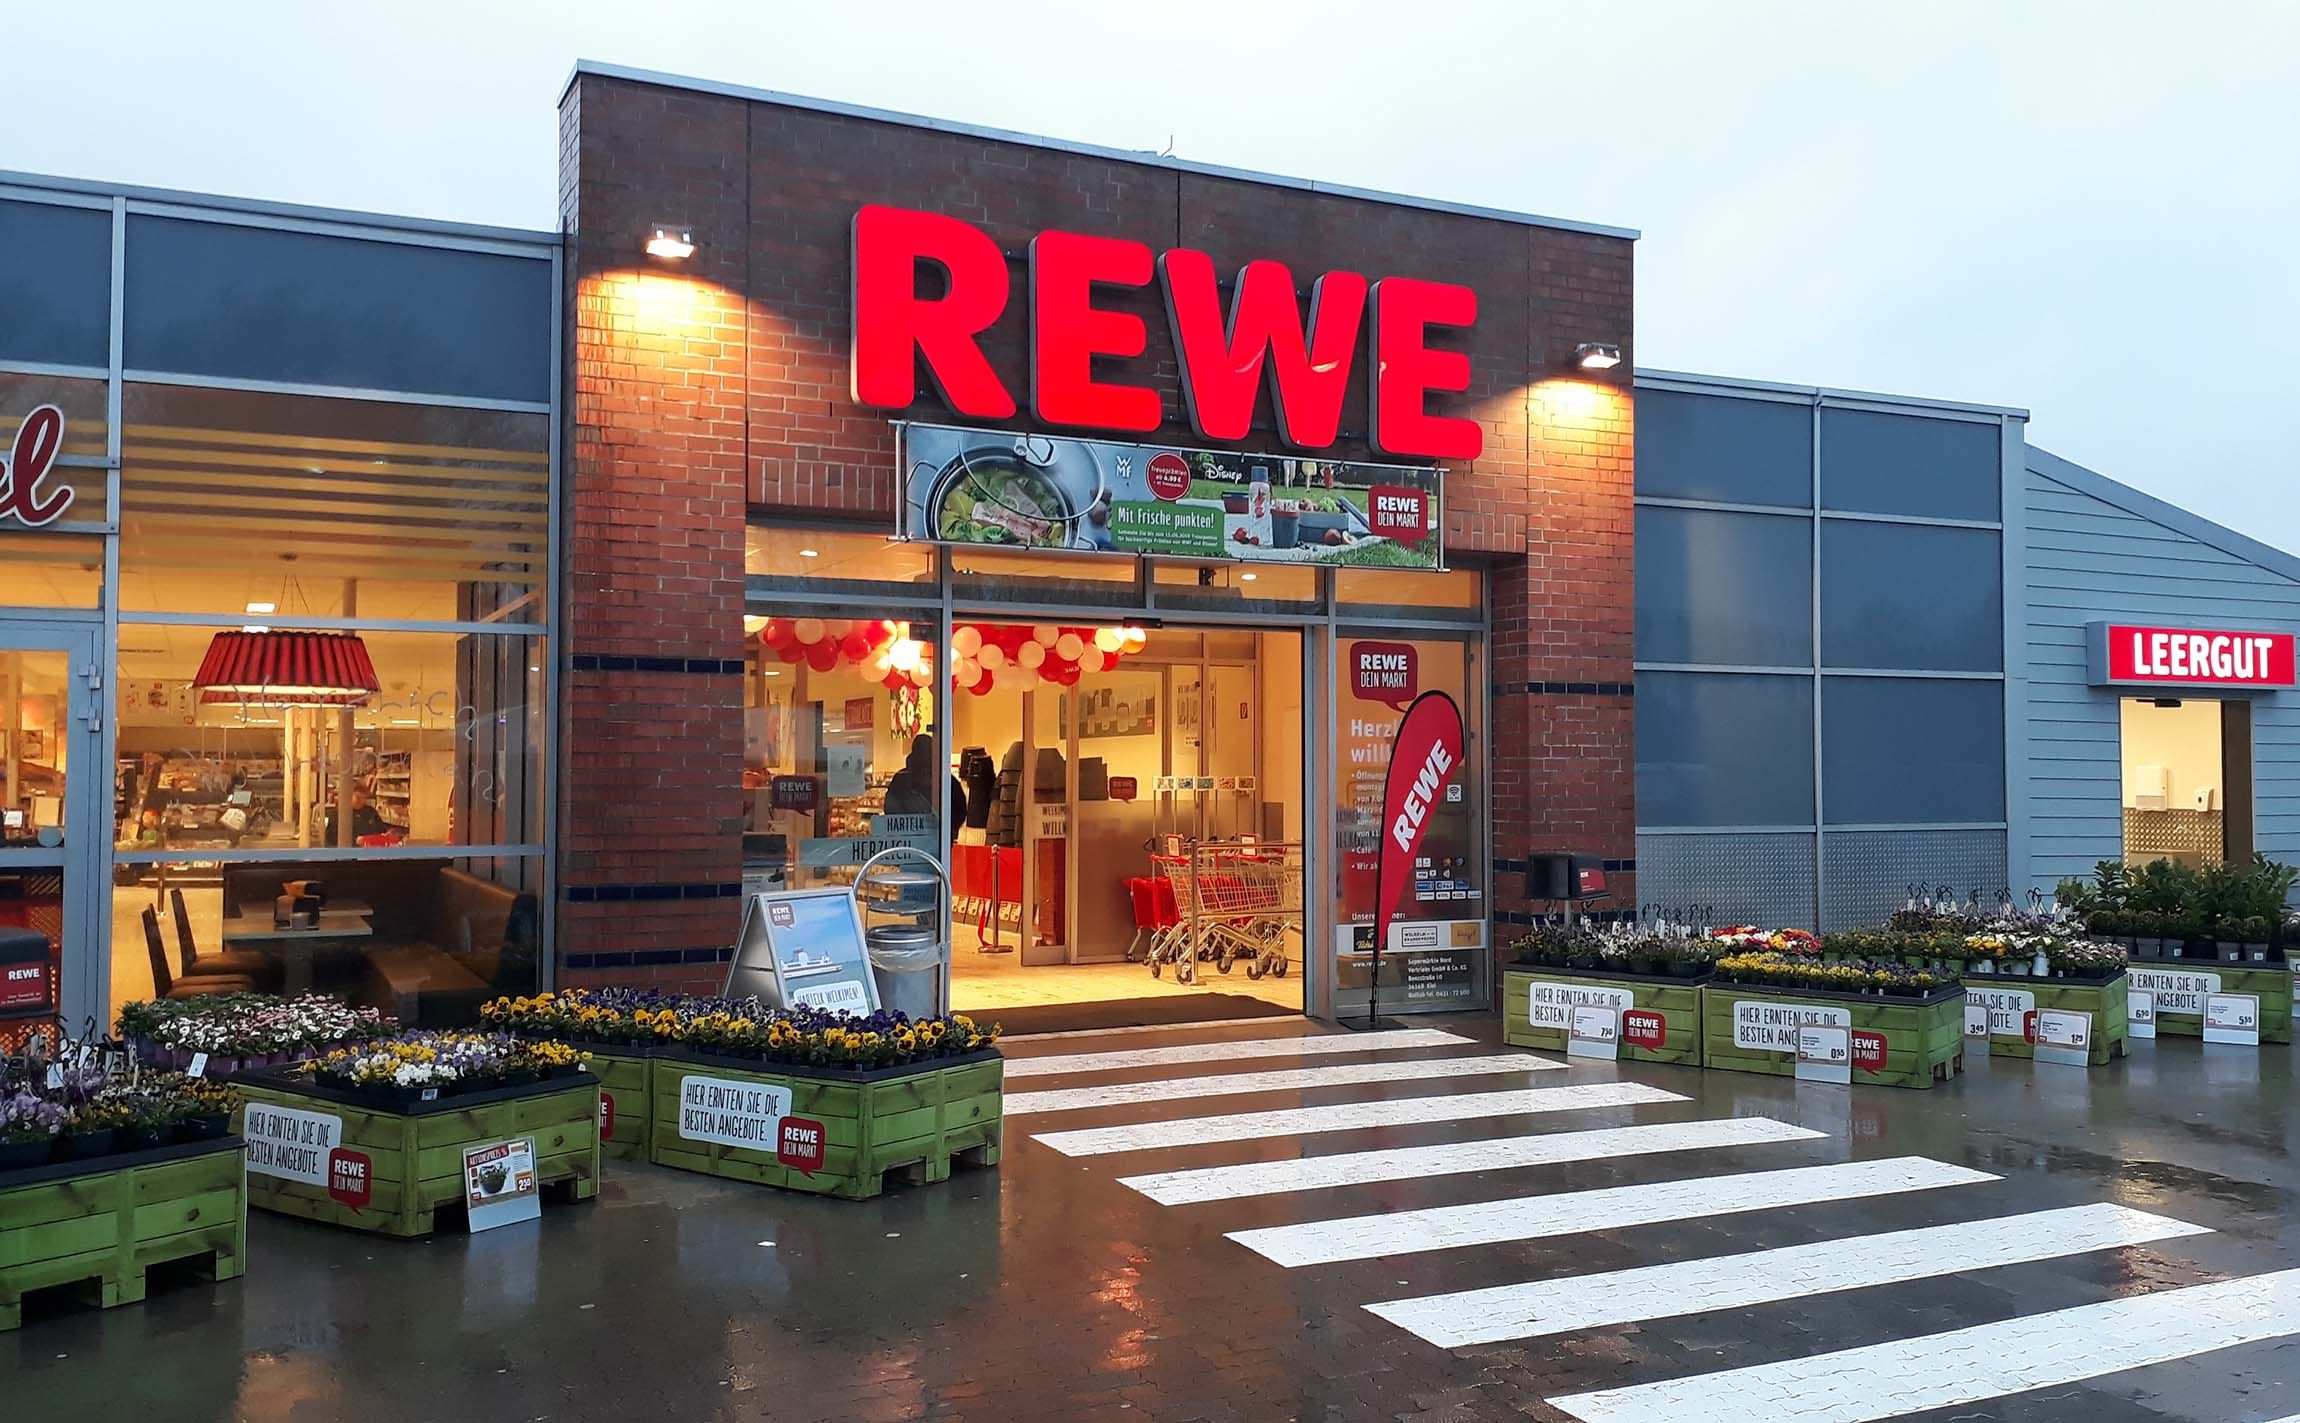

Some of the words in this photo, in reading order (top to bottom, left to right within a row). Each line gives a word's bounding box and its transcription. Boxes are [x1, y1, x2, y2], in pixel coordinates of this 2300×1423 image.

[852, 203, 1483, 461] REWE
[1377, 496, 1419, 513] REWE
[1118, 507, 1133, 523] Mit
[1138, 508, 1171, 526] Frische
[1175, 513, 1214, 529] punkten!
[1377, 511, 1395, 527] DEIN
[1396, 512, 1420, 529] MARKT
[1360, 654, 1408, 671] REWE
[2134, 632, 2273, 679] LEERGUT
[1360, 671, 1379, 688] DEIN
[1381, 671, 1408, 688] MARKT
[1392, 738, 1453, 854] REWE
[887, 815, 924, 832] HARTELK
[8, 968, 40, 981] REWE
[2137, 974, 2173, 989] ERNTEN
[2177, 977, 2191, 991] SIE
[2195, 979, 2208, 993] DIE
[1535, 987, 1554, 1003] HIER
[1556, 989, 1589, 1005] ERNTEN
[1990, 994, 2004, 1010] SIE
[2008, 996, 2022, 1012] DIE
[1535, 1005, 1565, 1023] BESTEN
[1628, 1017, 1659, 1028] REWE
[1740, 1007, 1760, 1024] HIER
[1764, 1008, 1800, 1027] ERNTEN
[1628, 1027, 1640, 1038] DEIN
[1641, 1028, 1659, 1040] MARKT
[1740, 1025, 1773, 1045] BESTEN
[1862, 1049, 1880, 1062] MARKT
[686, 1083, 705, 1106] HIER
[708, 1086, 743, 1111] ERNTEN
[747, 1091, 761, 1114] SIE
[764, 1094, 779, 1117] DIE
[248, 1111, 265, 1136] HIER
[267, 1114, 300, 1142] ERNTEN
[301, 1119, 316, 1145] SIE
[316, 1123, 331, 1148] DIE
[684, 1109, 715, 1133] BESTEN
[717, 1114, 768, 1142] ANGEBOTE.
[784, 1126, 818, 1144] REWE
[247, 1138, 274, 1166] BESTEN
[275, 1145, 320, 1175] ANGEBOTE.
[783, 1141, 797, 1156] DEIN
[798, 1144, 817, 1159] MARKT
[334, 1159, 365, 1178] REWE
[333, 1174, 346, 1191] DEIN
[346, 1177, 364, 1193] MARKT
